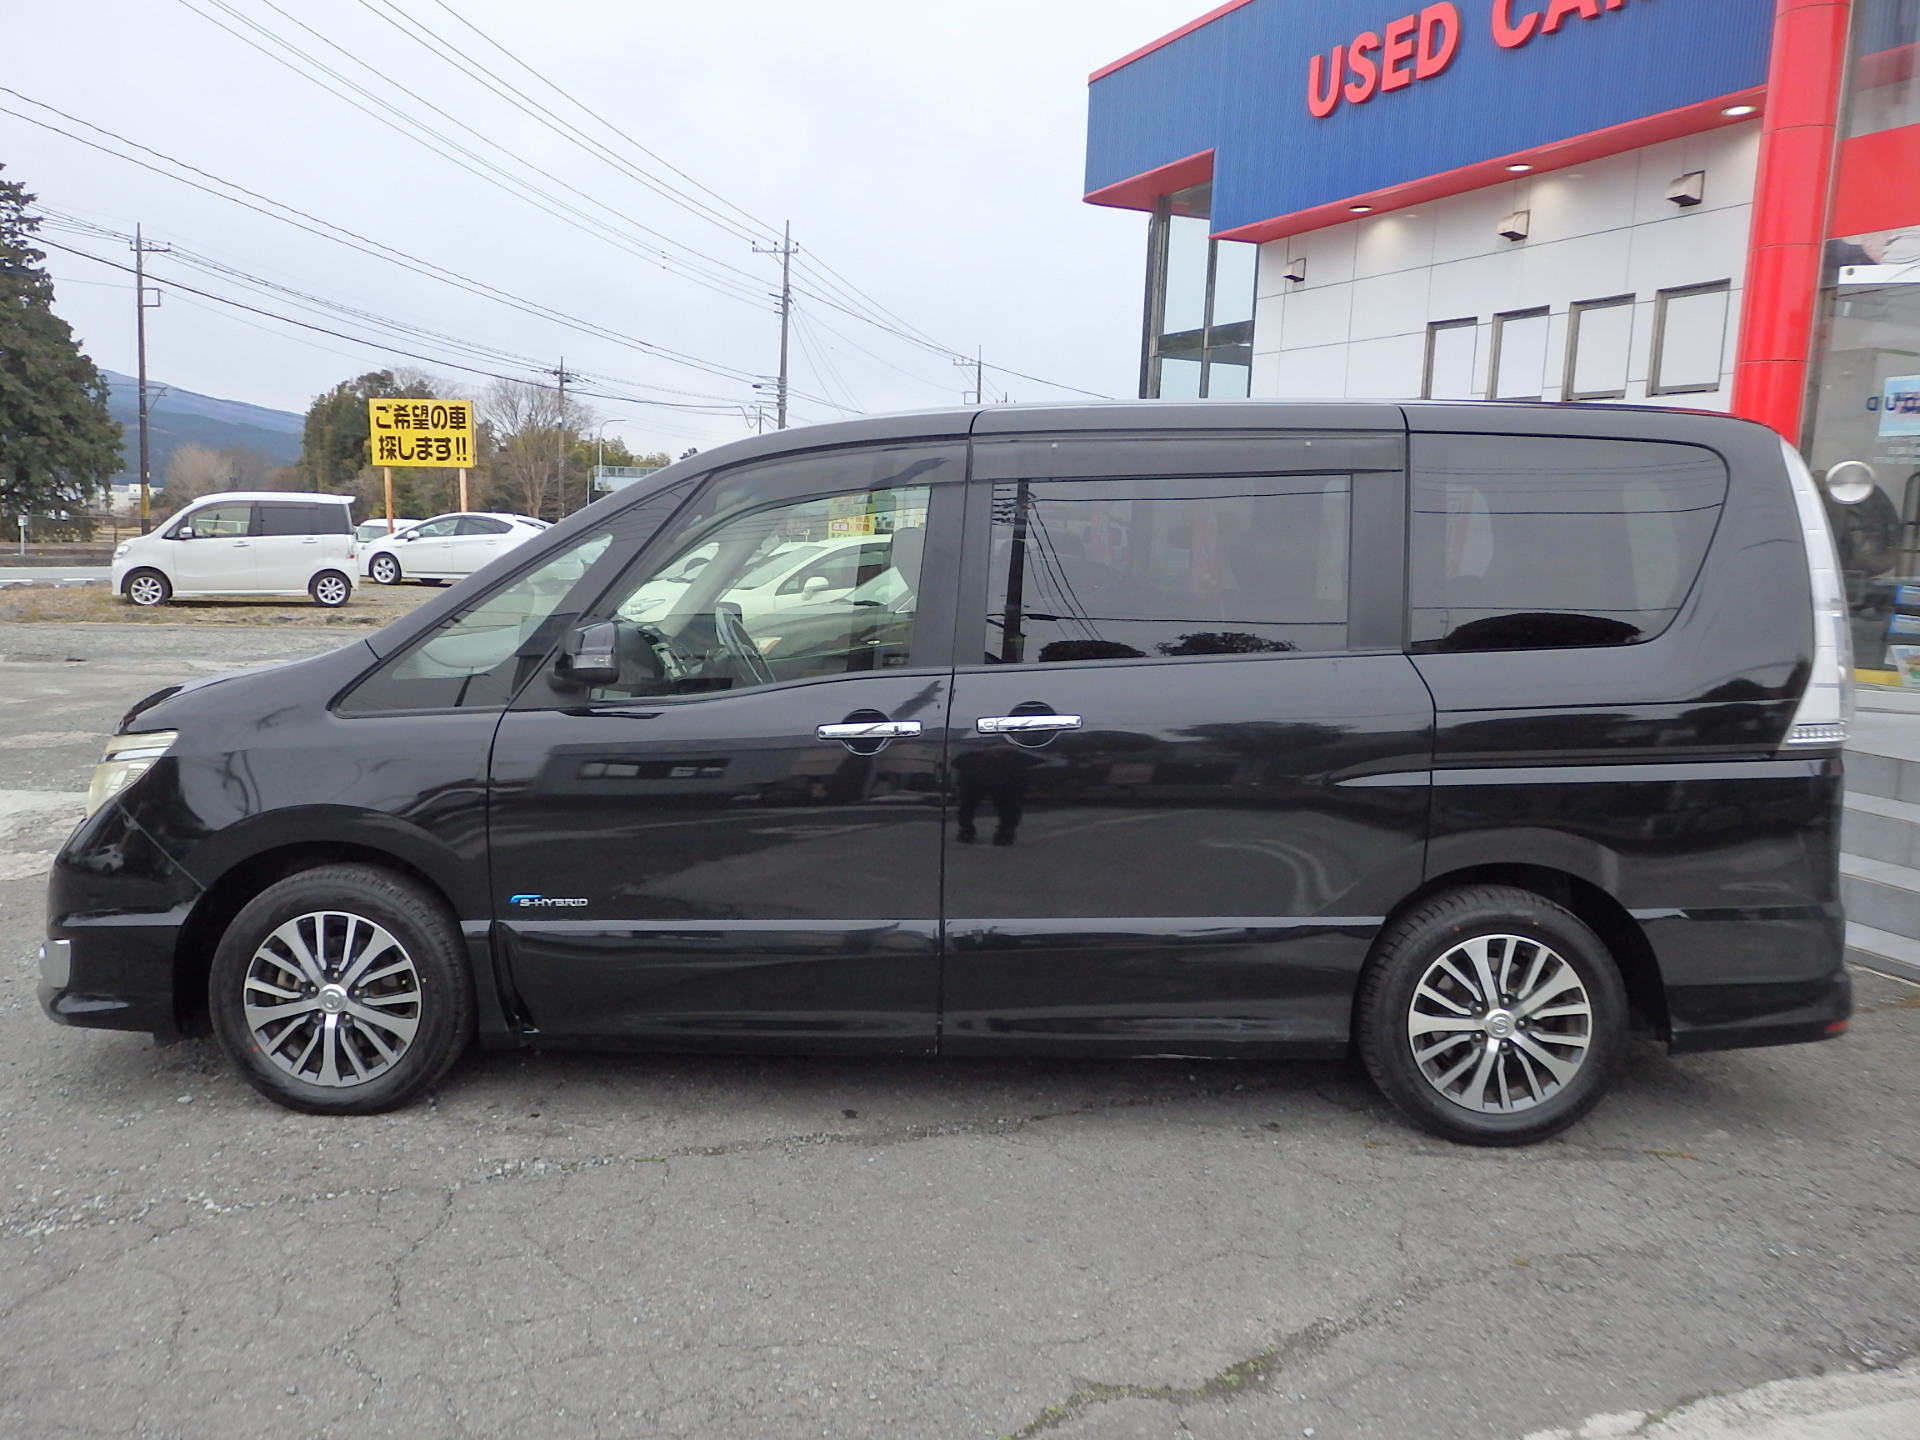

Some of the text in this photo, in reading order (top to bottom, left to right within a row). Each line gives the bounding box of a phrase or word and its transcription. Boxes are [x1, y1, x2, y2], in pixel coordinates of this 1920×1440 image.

[1308, 1, 1461, 117] USED
[376, 404, 467, 430] ご希望の車
[520, 898, 588, 907] S-HYBRID
